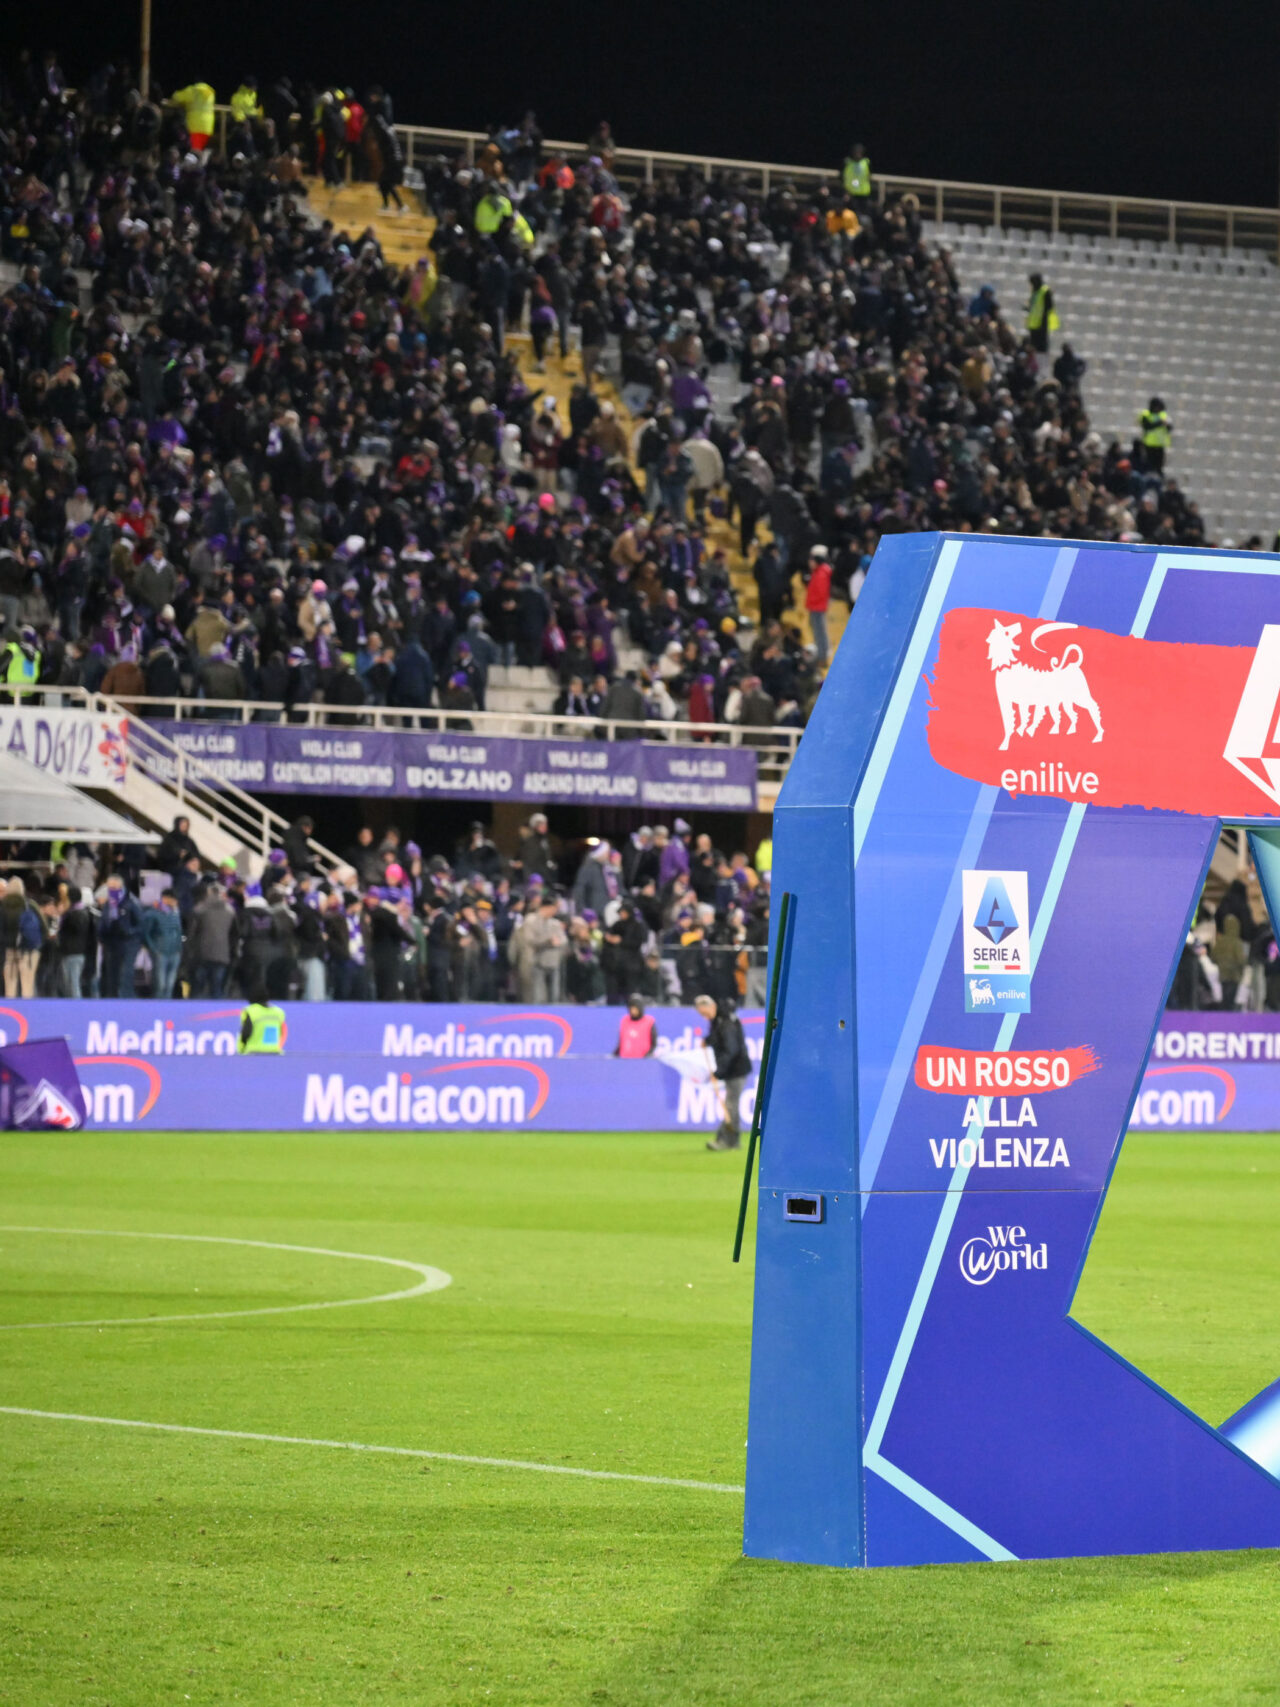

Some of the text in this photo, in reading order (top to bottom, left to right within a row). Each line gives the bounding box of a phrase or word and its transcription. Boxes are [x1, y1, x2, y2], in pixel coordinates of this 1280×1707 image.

[334, 741, 363, 759] CLUB
[459, 746, 487, 764] CLUB
[580, 752, 608, 770] CLUB
[406, 766, 513, 792] BOLZANO
[1000, 761, 1099, 793] enilive
[973, 948, 1020, 961] SERIE A
[997, 989, 1027, 1000] enilive
[87, 1019, 242, 1055] Mediaco
[382, 1022, 555, 1058] Mediacom
[926, 1056, 1071, 1087] UN ROSSO
[303, 1072, 525, 1123] Mediacom
[962, 1097, 1038, 1127] ALLA
[929, 1138, 1070, 1168] VIOLENZA
